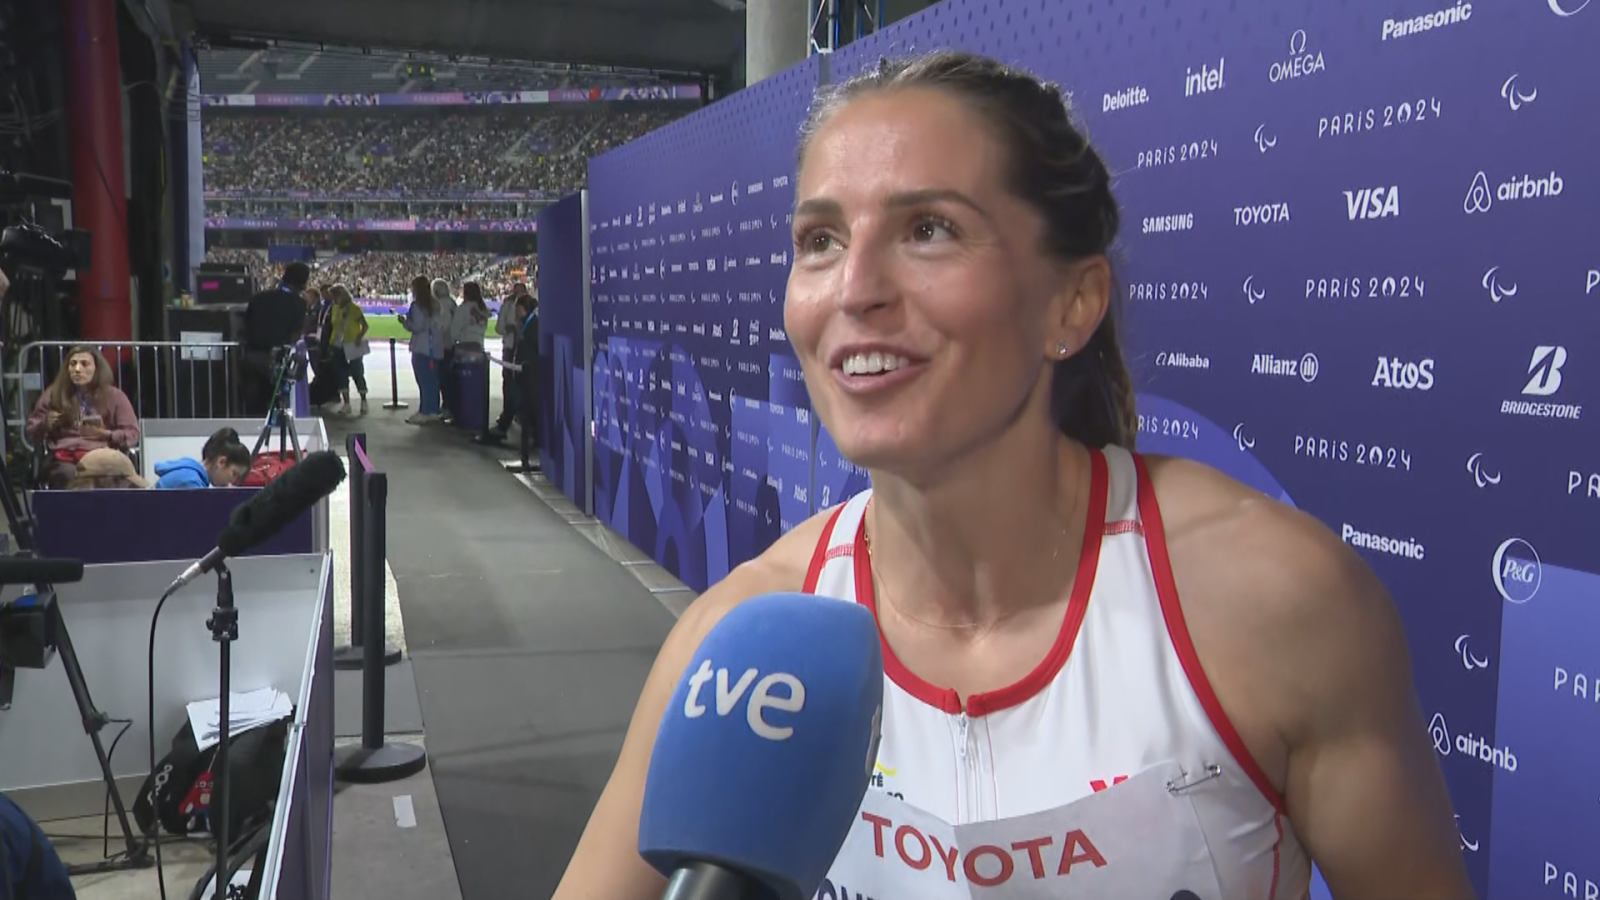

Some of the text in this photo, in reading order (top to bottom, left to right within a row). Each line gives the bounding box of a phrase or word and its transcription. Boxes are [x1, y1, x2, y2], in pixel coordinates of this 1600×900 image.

[1382, 1, 1472, 40] Panasonic
[1185, 58, 1225, 97] intel
[1269, 52, 1325, 82] OMEGA
[1497, 171, 1564, 201] airbnb
[1233, 203, 1290, 226] TOYOTA
[1343, 186, 1399, 220] VISA
[1142, 213, 1194, 234] SAMSUNG
[1167, 352, 1210, 369] Alibaba
[1251, 354, 1298, 376] Allianz
[795, 407, 809, 425] VISA
[1500, 400, 1582, 419] BRIDGESTONE
[1341, 523, 1425, 560] Panasonic
[1502, 558, 1537, 584] P&G
[683, 659, 806, 740] tve
[1455, 733, 1518, 771] airbnb
[861, 811, 1107, 887] TOYOTA
